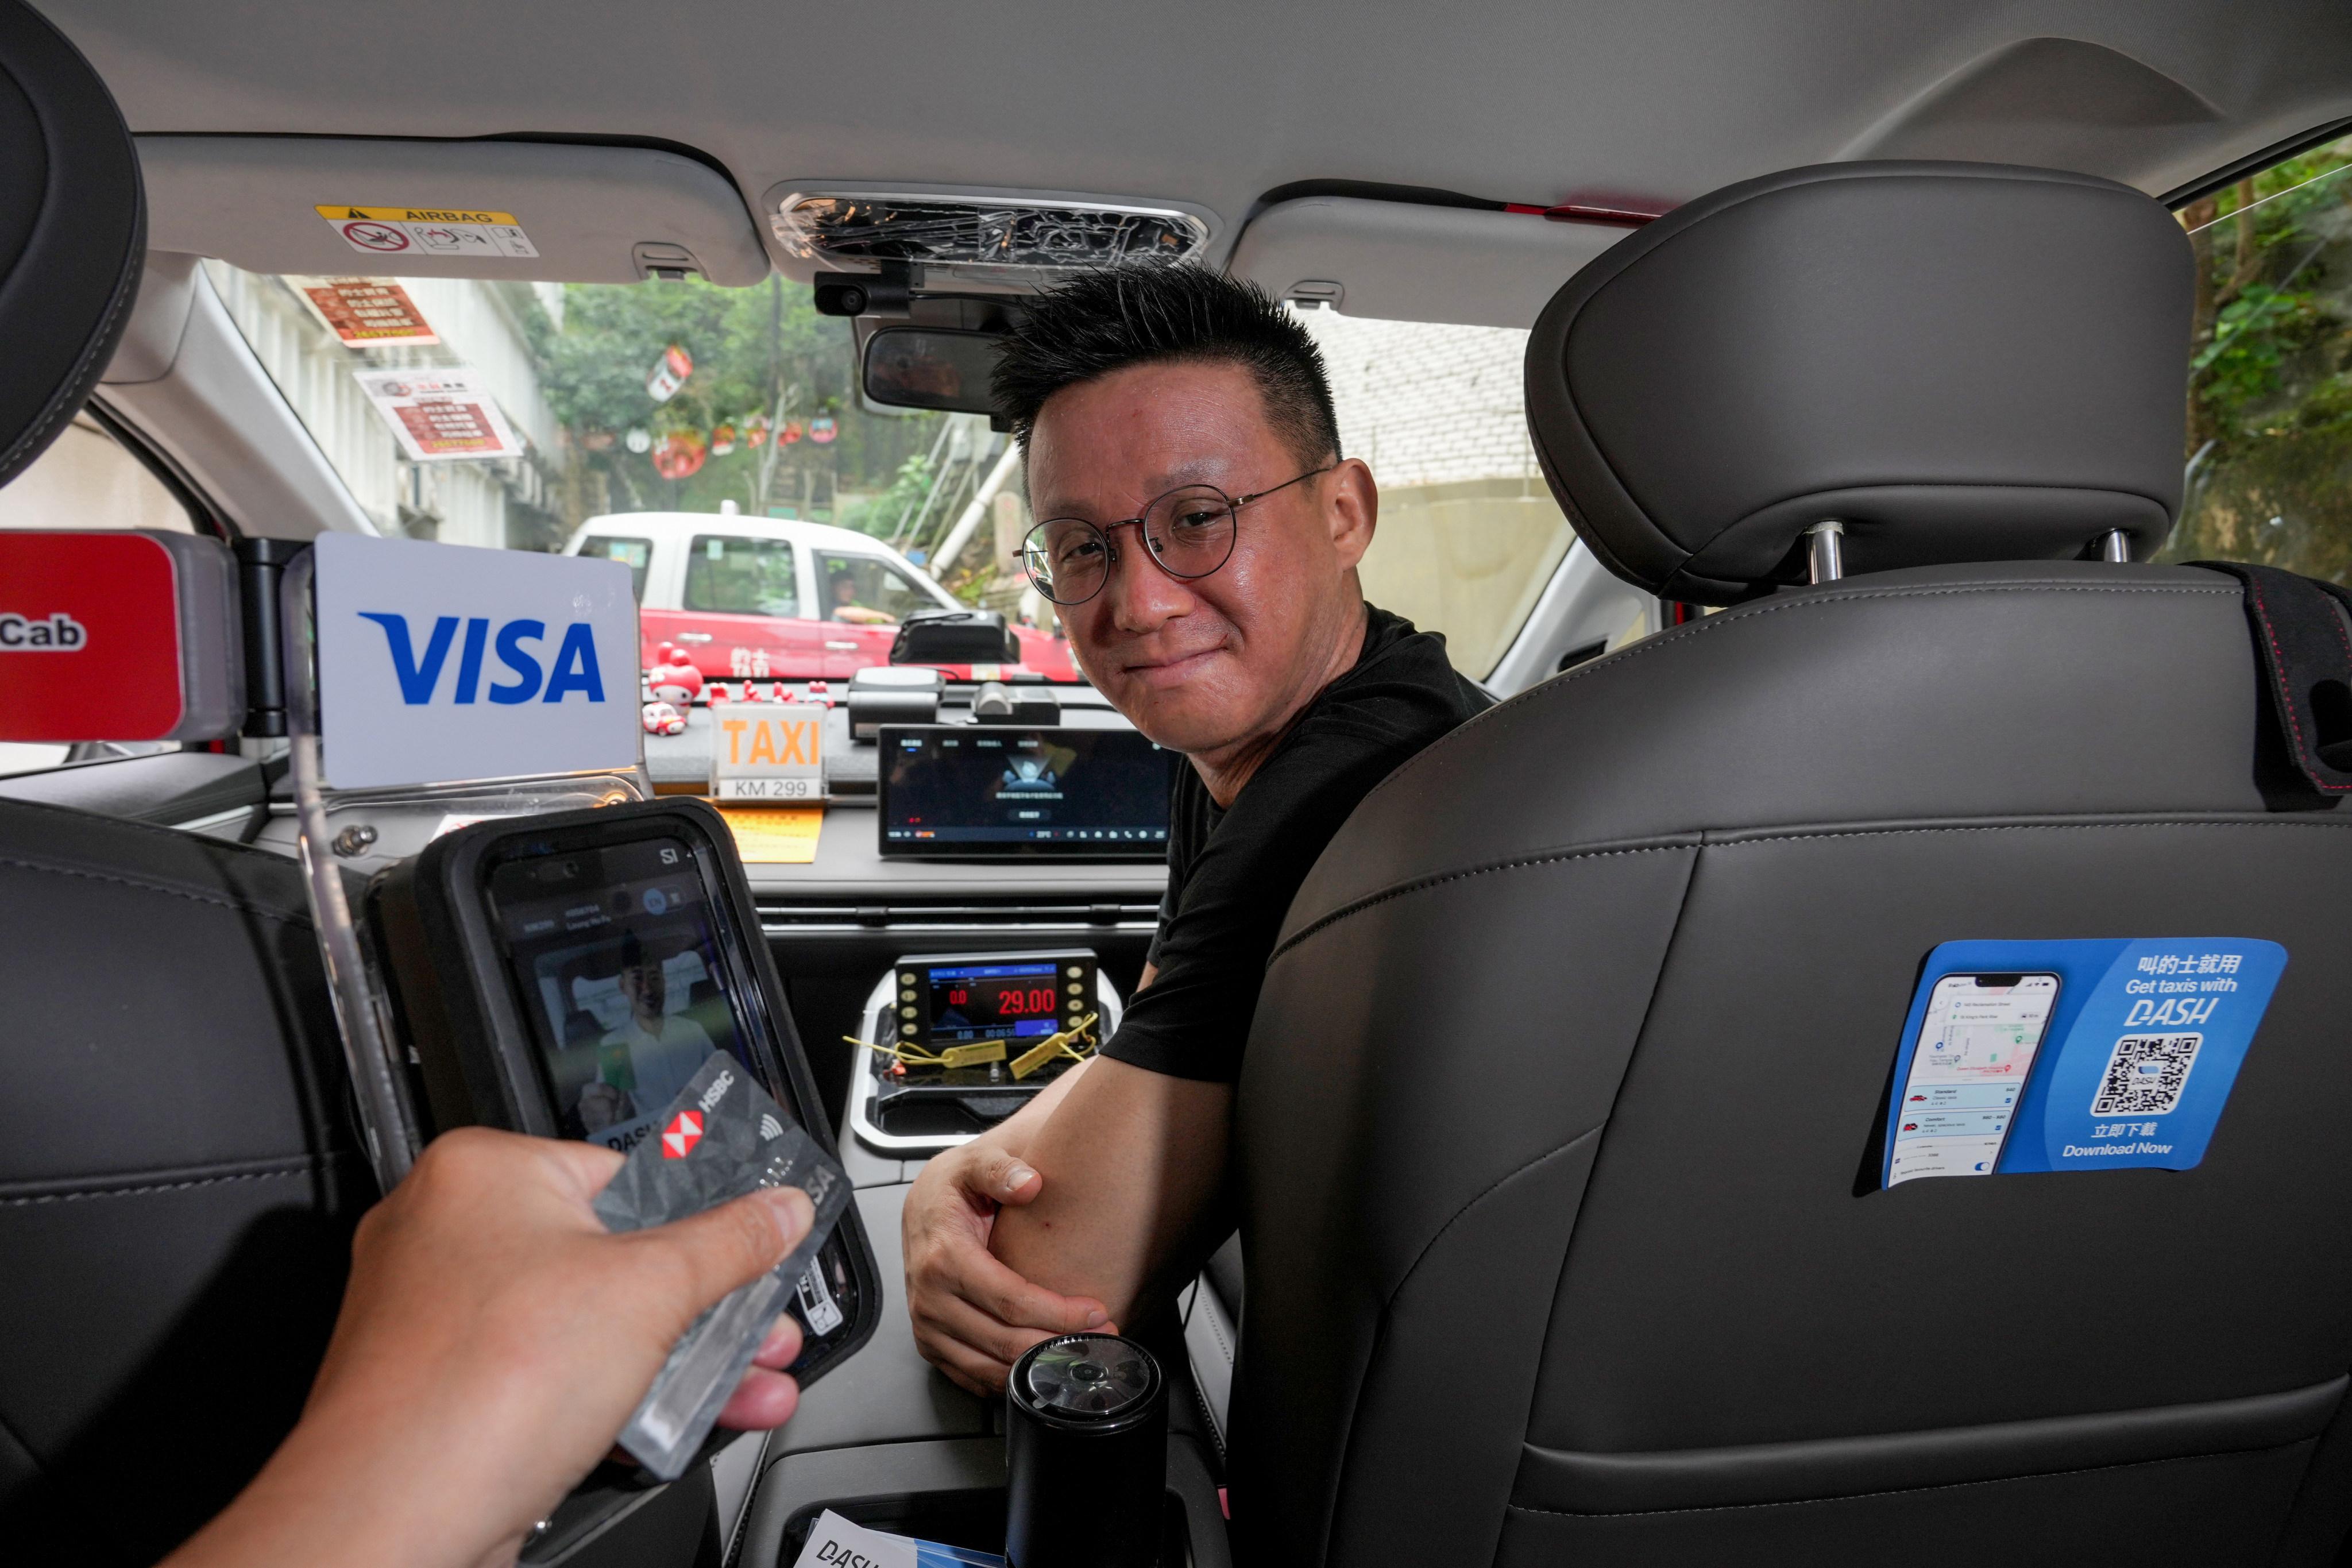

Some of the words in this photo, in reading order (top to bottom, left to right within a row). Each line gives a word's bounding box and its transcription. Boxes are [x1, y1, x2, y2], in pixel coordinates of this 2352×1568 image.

[405, 210, 493, 223] AIRBAG
[0, 618, 80, 645] Cab
[357, 611, 605, 705] VISA
[730, 646, 770, 666] 的士
[723, 720, 819, 764] TAXI
[735, 782, 766, 796] KM
[774, 781, 807, 796] 299
[2137, 954, 2243, 975] 叫的士就用
[2125, 979, 2157, 994] Get
[2158, 978, 2197, 993] taxis
[2200, 977, 2238, 992] with
[949, 989, 968, 1005] 0.0
[998, 988, 1056, 1015] 29.00
[2123, 997, 2220, 1027] DASH
[698, 1069, 735, 1114] HSBC
[607, 1123, 650, 1152] DAS
[2090, 1122, 2158, 1138] 立即下載
[2062, 1142, 2137, 1157] Download
[2136, 1141, 2173, 1154] Now
